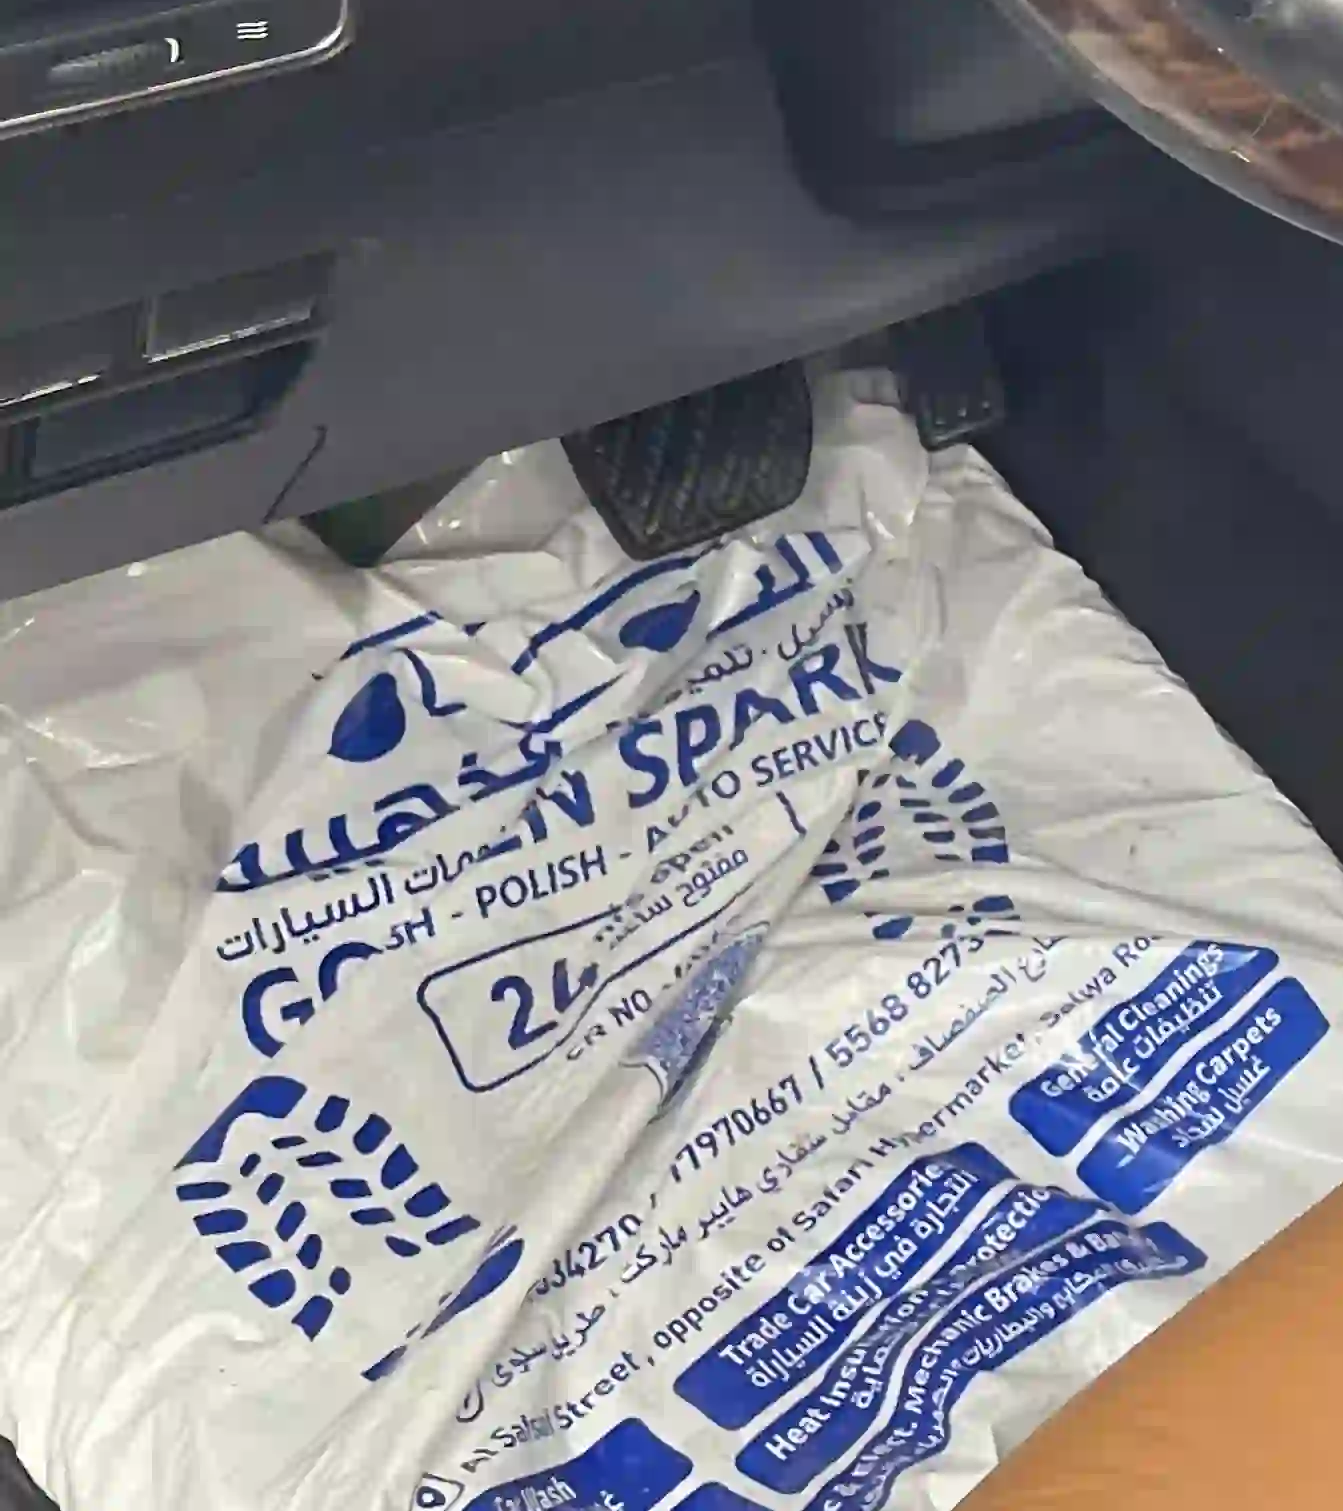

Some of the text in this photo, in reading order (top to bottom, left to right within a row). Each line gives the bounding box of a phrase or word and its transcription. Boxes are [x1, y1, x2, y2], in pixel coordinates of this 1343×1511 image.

[618, 622, 903, 808] SPARK
[216, 872, 395, 961] السيارات
[475, 845, 609, 919] POLISH
[608, 989, 654, 1028] NO
[824, 993, 909, 1068] 5568
[1117, 941, 1225, 1033] Cleanings
[1117, 1005, 1283, 1156] Washing Carpets
[654, 1252, 767, 1351] opposite
[766, 1225, 797, 1253] of
[791, 1157, 875, 1233] Safari
[718, 1163, 945, 1367] Trade Car Accessorie
[904, 1303, 993, 1415] Mechanic
[983, 1253, 1070, 1313] Brakes
[764, 1406, 832, 1462] Heat
